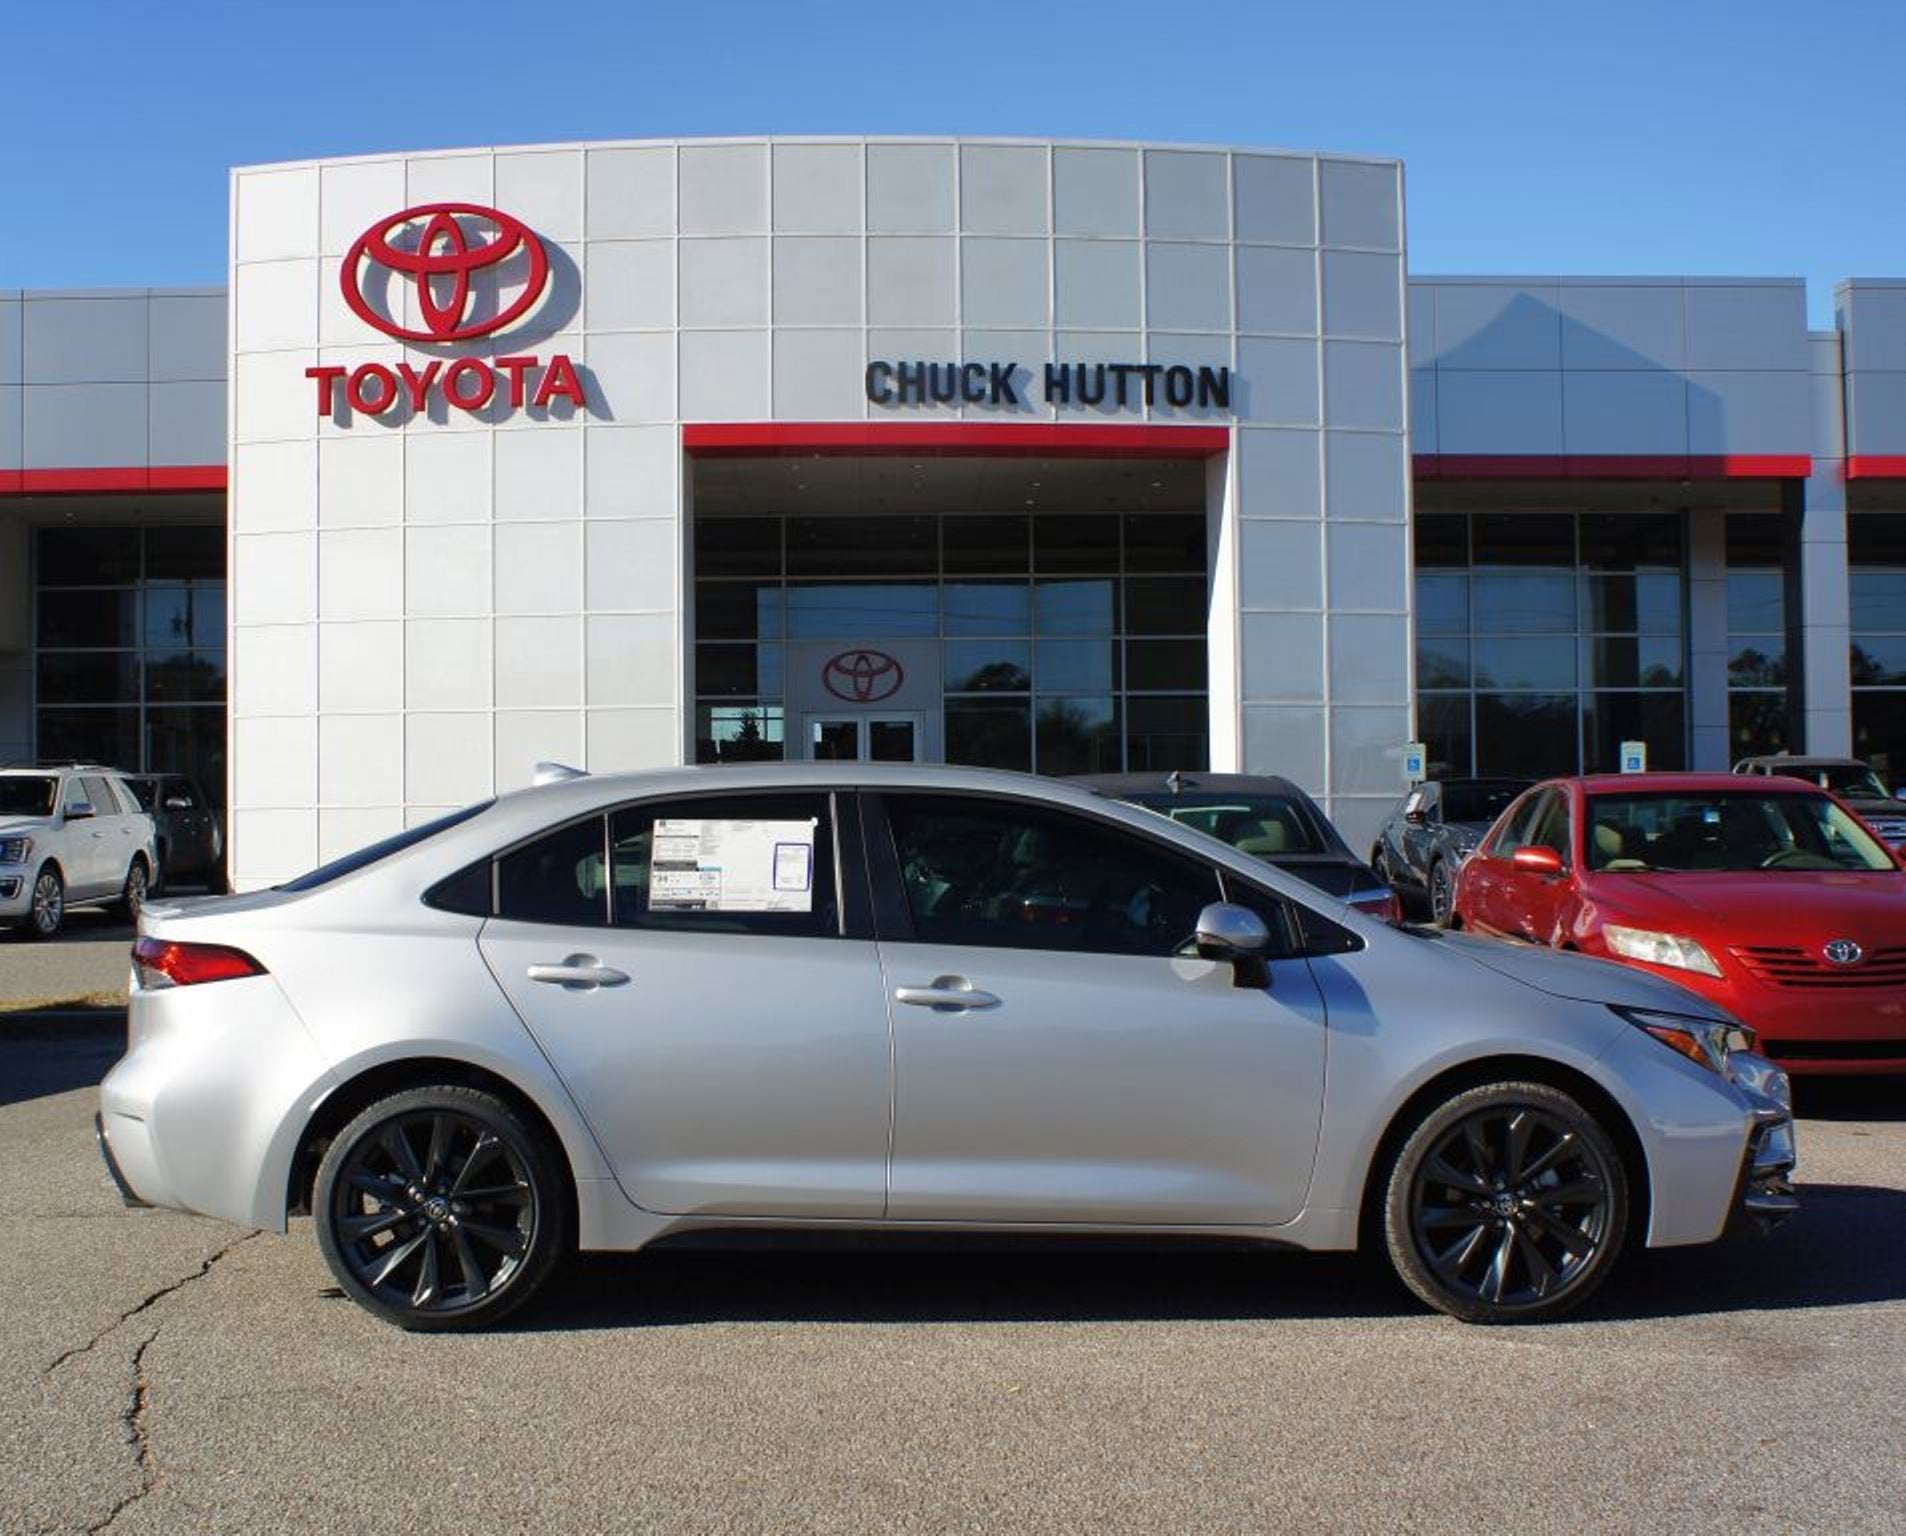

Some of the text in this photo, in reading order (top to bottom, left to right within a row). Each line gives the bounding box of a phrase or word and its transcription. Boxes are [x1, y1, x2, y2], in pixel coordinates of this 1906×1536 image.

[305, 354, 586, 416] TOYOTA
[865, 360, 1231, 408] CHUCK HUTTON
